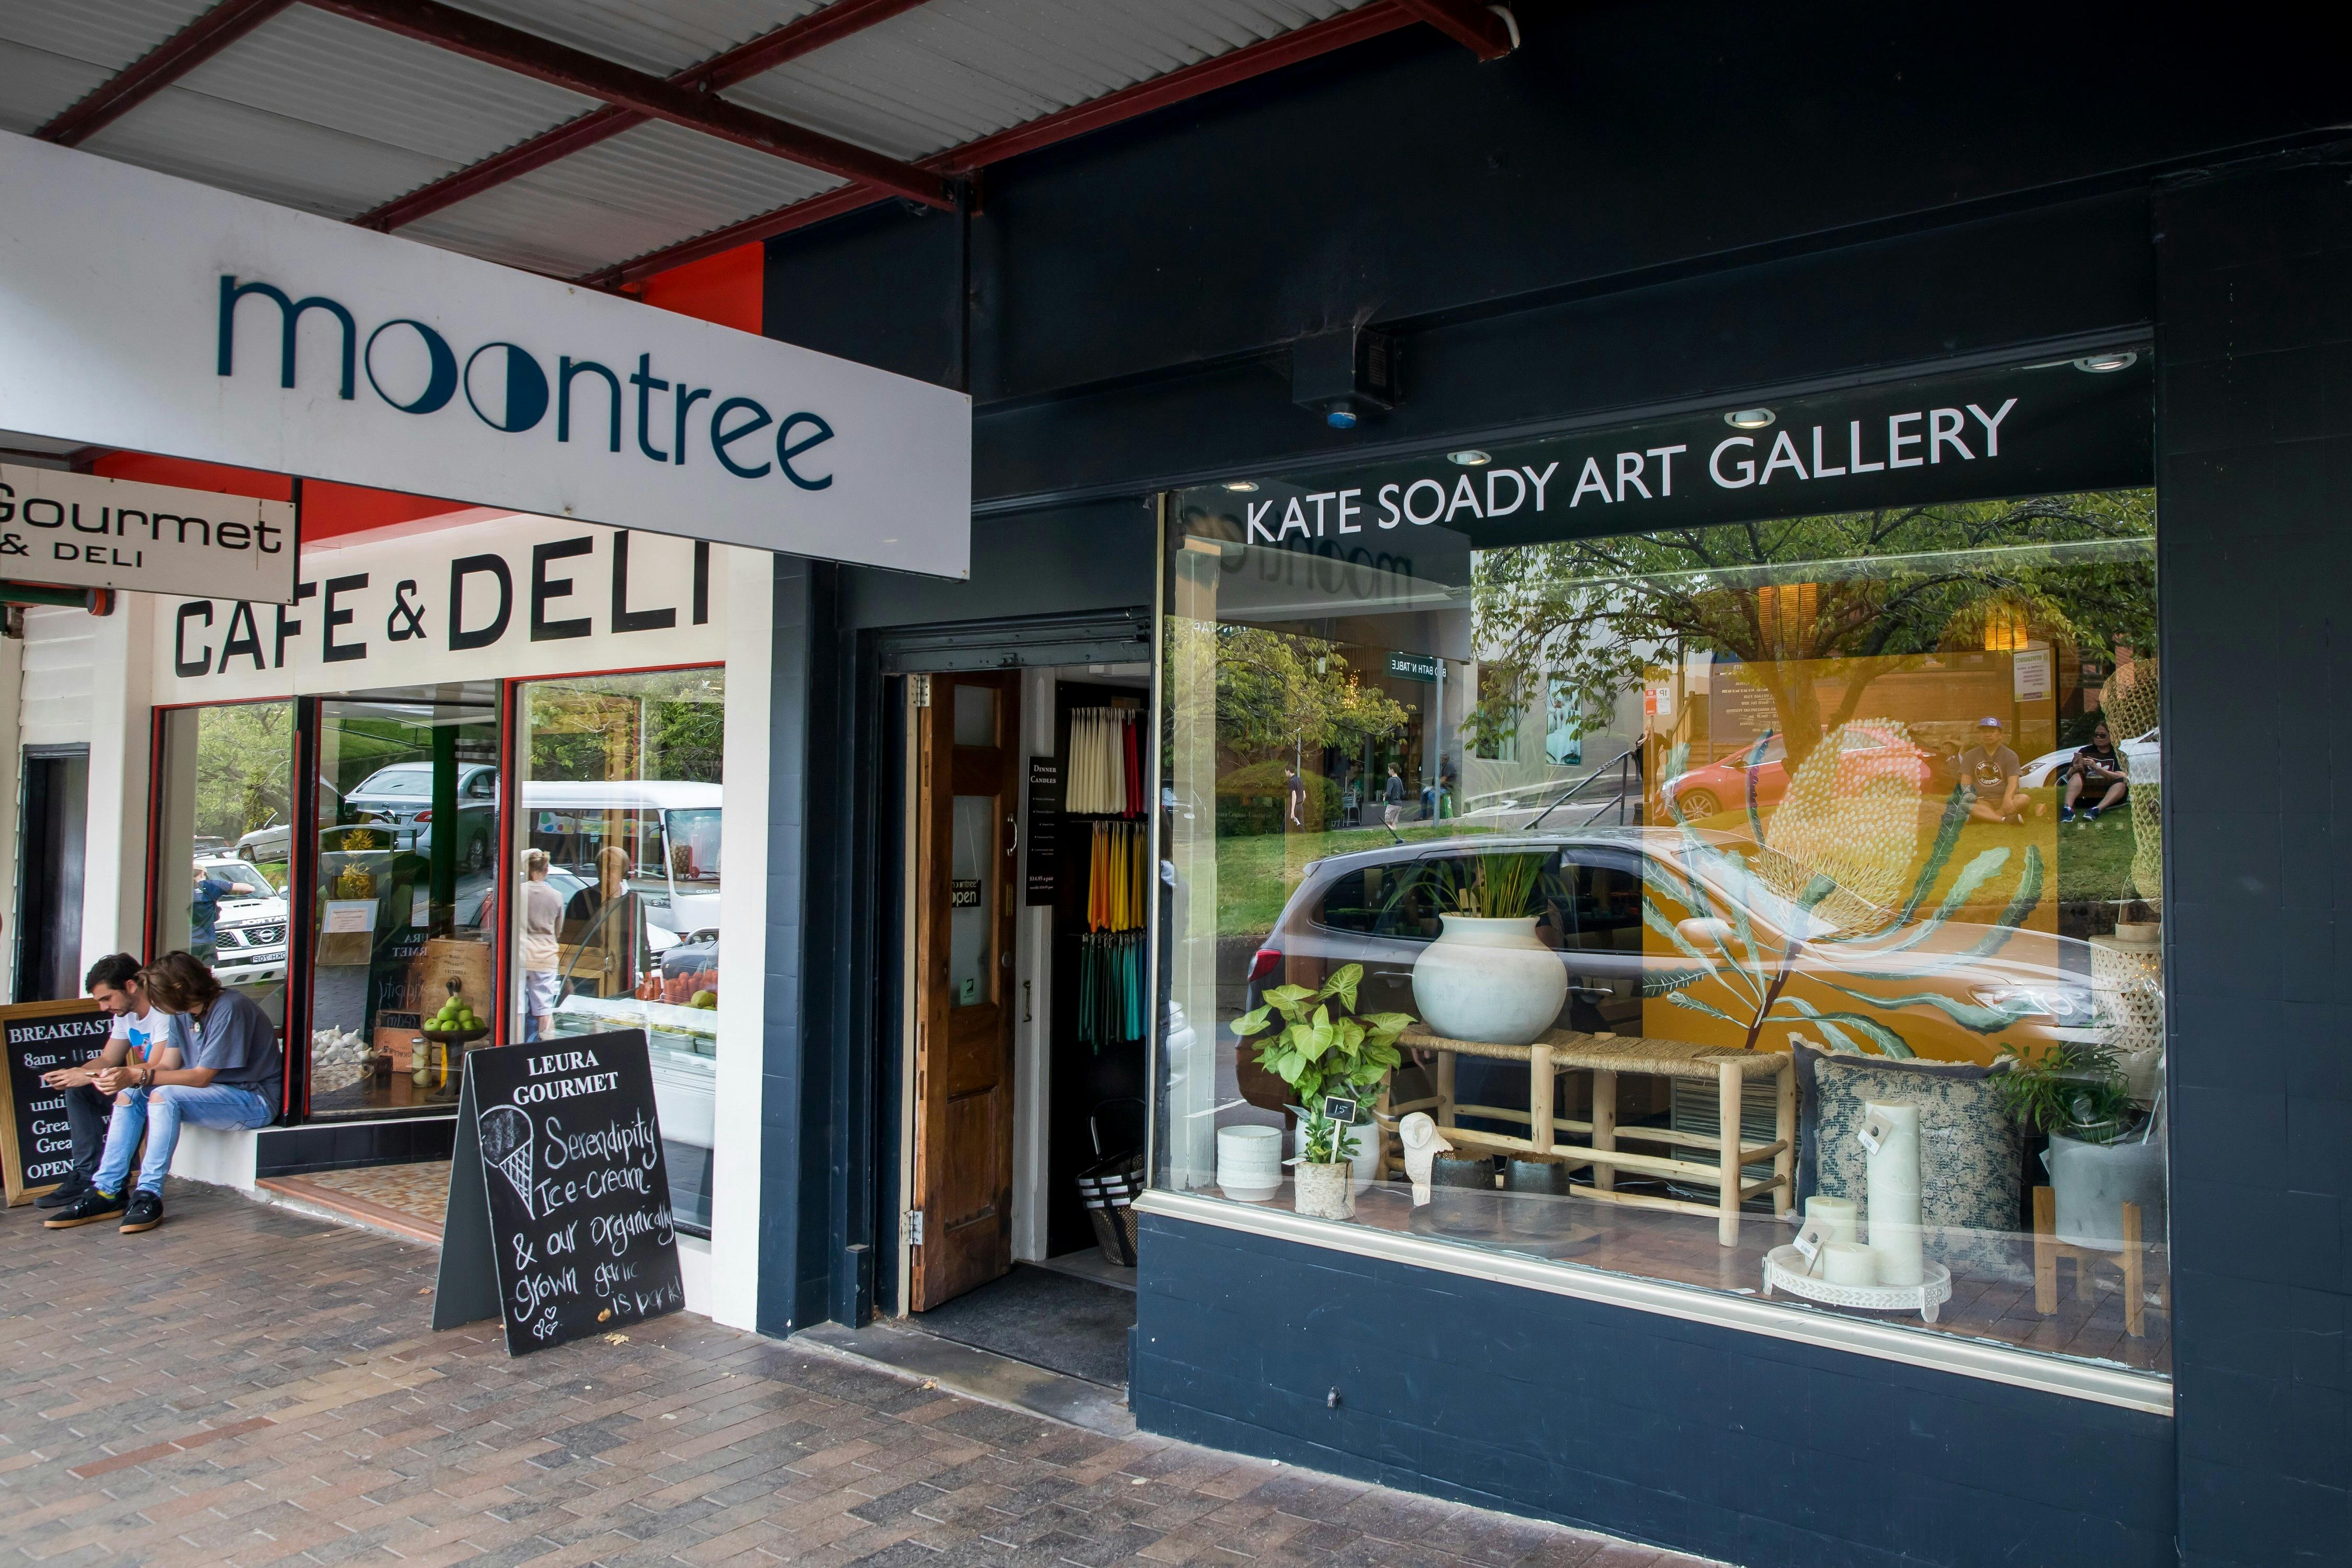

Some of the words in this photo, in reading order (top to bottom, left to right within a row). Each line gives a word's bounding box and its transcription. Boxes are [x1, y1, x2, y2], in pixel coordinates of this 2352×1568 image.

[217, 275, 835, 491] moontree
[1247, 488, 1361, 544] KATE
[1378, 462, 1558, 529] SOADY
[1570, 444, 1686, 508] ART
[1709, 398, 2018, 489] GALLERY
[0, 533, 30, 557] &
[54, 541, 143, 568] DELI
[175, 572, 370, 678] CAFE
[387, 579, 428, 642] &
[449, 530, 710, 651] DELI
[9, 1019, 114, 1043] BREAKFAST
[24, 1053, 58, 1067] 8am
[527, 1049, 600, 1076] LEURA
[513, 1071, 618, 1105] GOURMET
[30, 1093, 67, 1112] unti
[1335, 1104, 1348, 1113] 15
[32, 1120, 71, 1135] Grea
[545, 1108, 657, 1170] Serendipity
[36, 1138, 73, 1153] Grea
[27, 1159, 75, 1179] OPEN
[513, 1232, 537, 1271] &
[547, 1219, 578, 1255] our
[514, 1267, 580, 1322] grown
[594, 1261, 638, 1297] garlic
[611, 1290, 632, 1316] is
